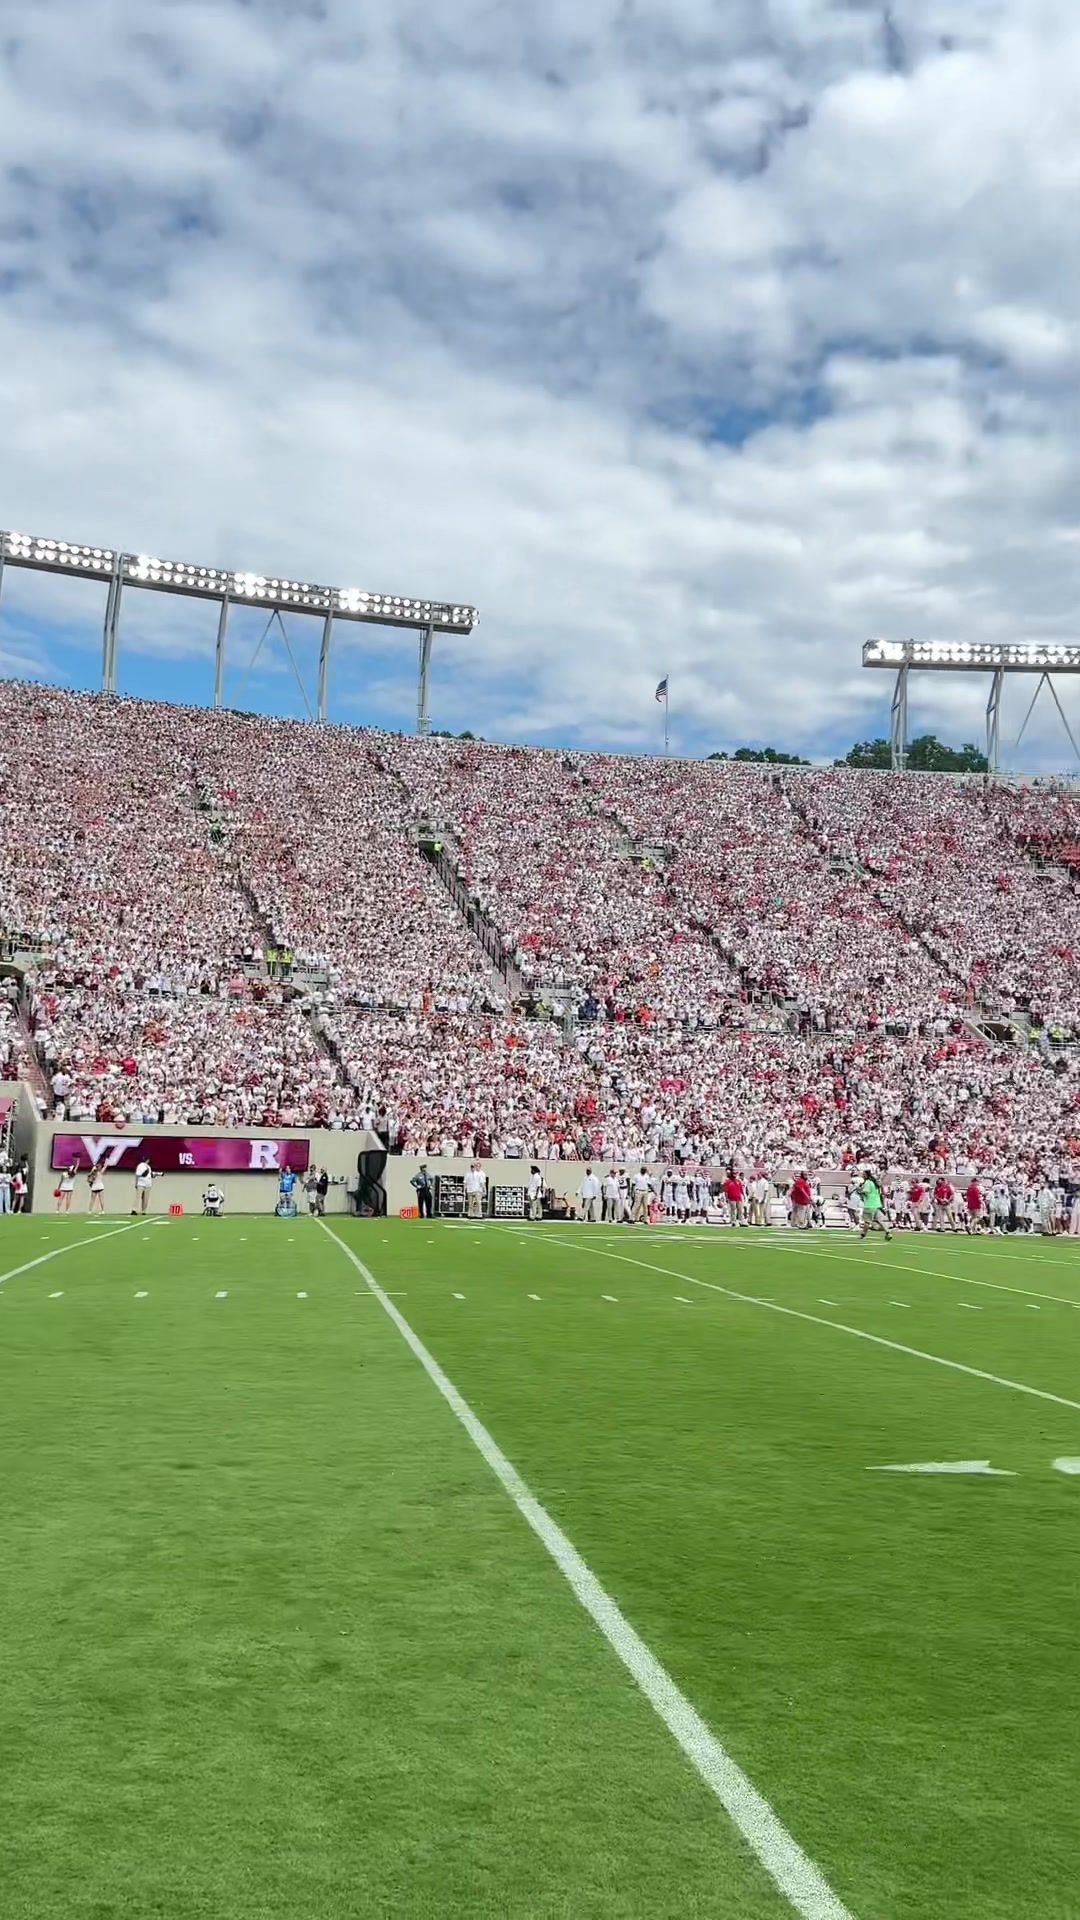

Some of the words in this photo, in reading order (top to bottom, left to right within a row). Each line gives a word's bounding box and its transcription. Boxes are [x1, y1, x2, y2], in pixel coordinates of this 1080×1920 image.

[80, 1135, 144, 1167] VT
[178, 1152, 195, 1165] VS.
[249, 1140, 280, 1169] R
